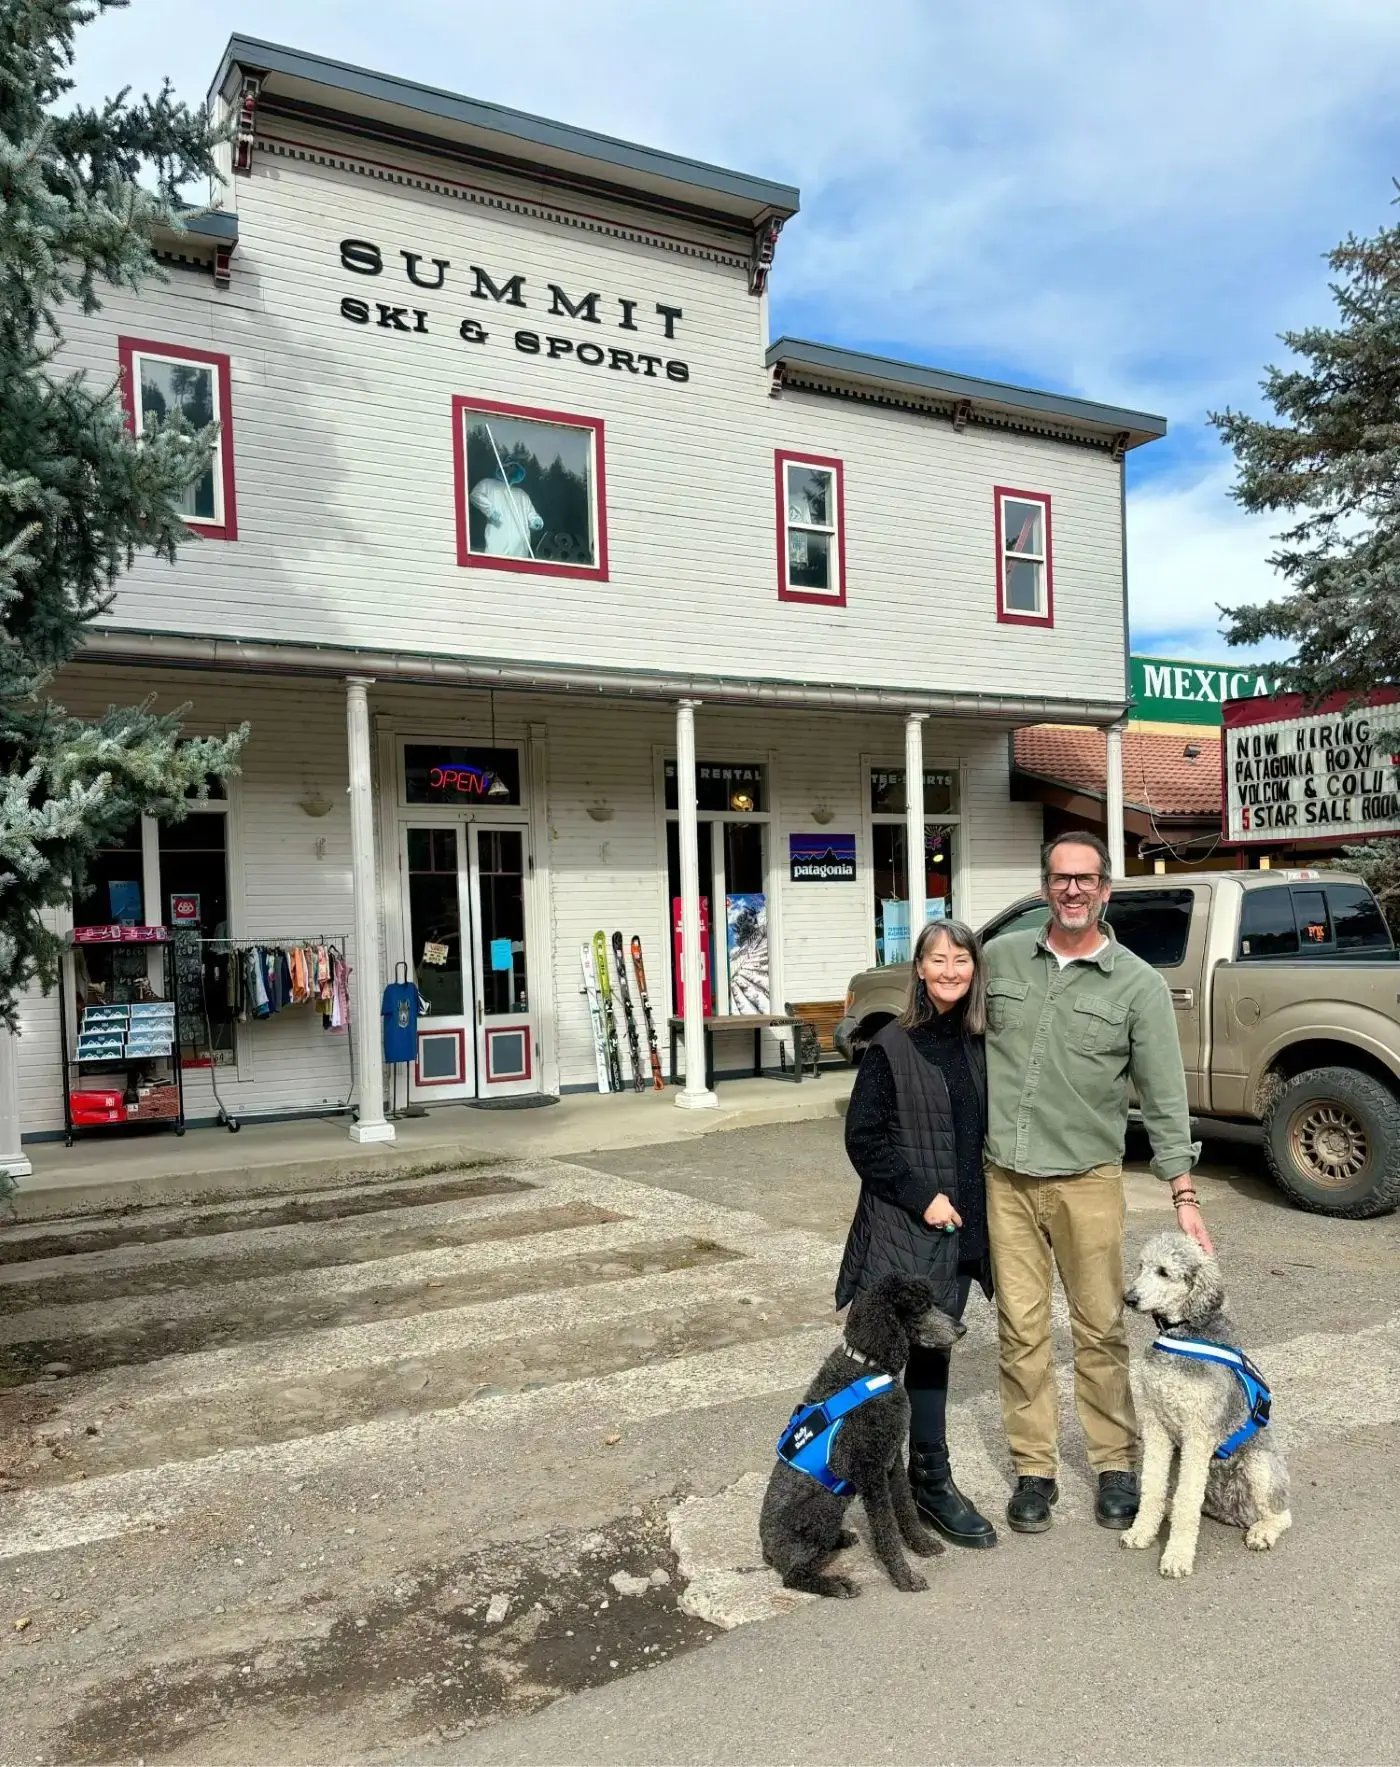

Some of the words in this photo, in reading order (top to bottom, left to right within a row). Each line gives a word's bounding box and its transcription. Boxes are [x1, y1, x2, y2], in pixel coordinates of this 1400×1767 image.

[340, 239, 682, 339] SUMMIT
[341, 297, 429, 333] SKI
[460, 319, 489, 344] &
[514, 331, 690, 382] SPORTS
[1143, 665, 1292, 702] MEXICA
[1237, 733, 1278, 758] NOW
[1297, 720, 1370, 751] HIRING
[700, 767, 762, 780] RENTAL
[1235, 752, 1314, 782] PATAGONIA
[1326, 745, 1373, 772] ROXY
[430, 768, 485, 795] OPEN
[1238, 780, 1290, 805] VOLCOM
[1304, 777, 1317, 798] &
[1305, 798, 1351, 823] SALE
[793, 864, 853, 877] patagonia
